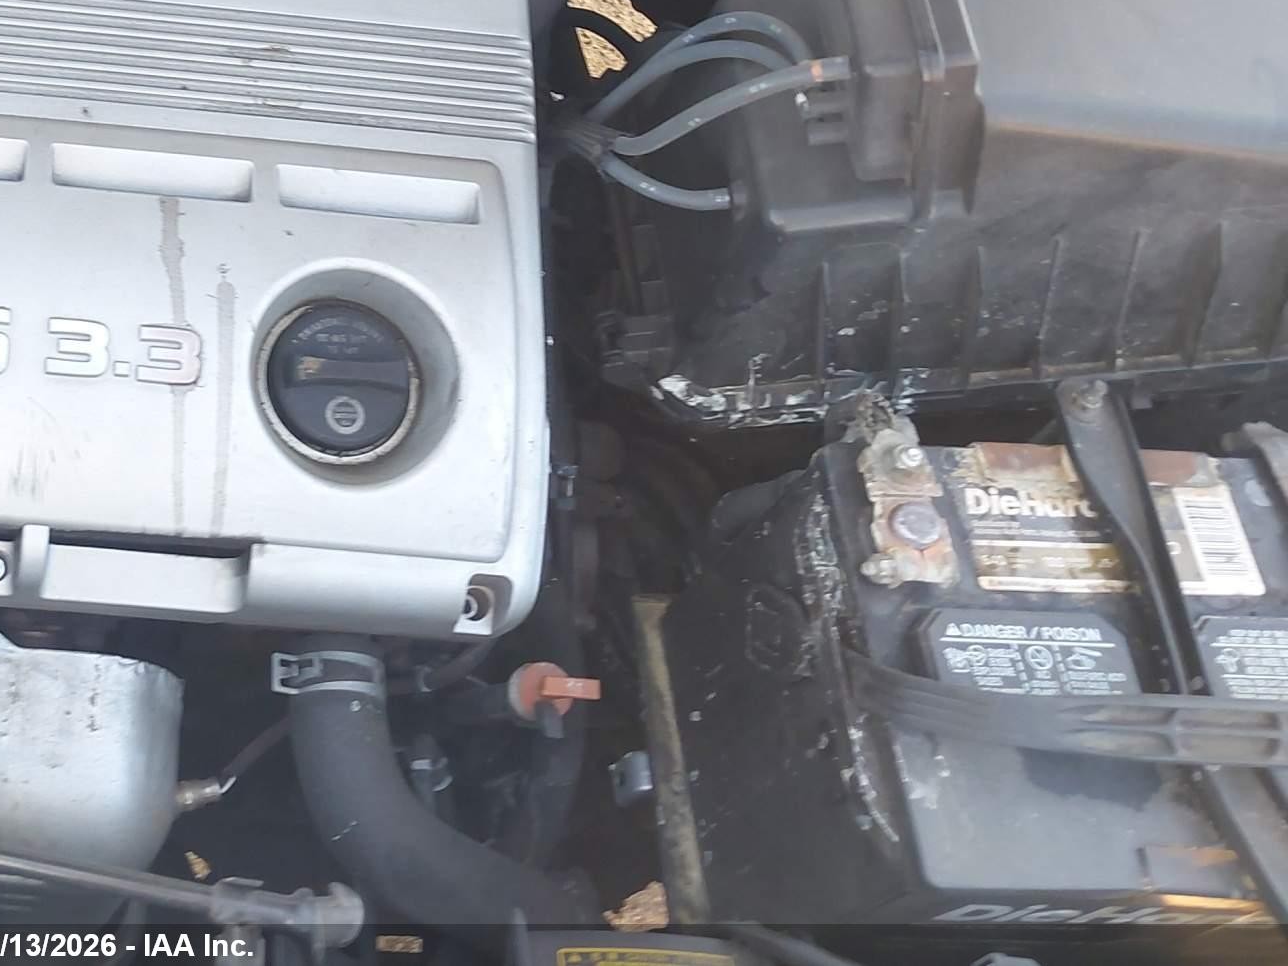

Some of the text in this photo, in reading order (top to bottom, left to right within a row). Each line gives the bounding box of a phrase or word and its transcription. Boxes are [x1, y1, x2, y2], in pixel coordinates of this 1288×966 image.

[43, 316, 204, 386] 3.3
[959, 622, 1027, 638] DANGER
[1039, 626, 1103, 642] POISON
